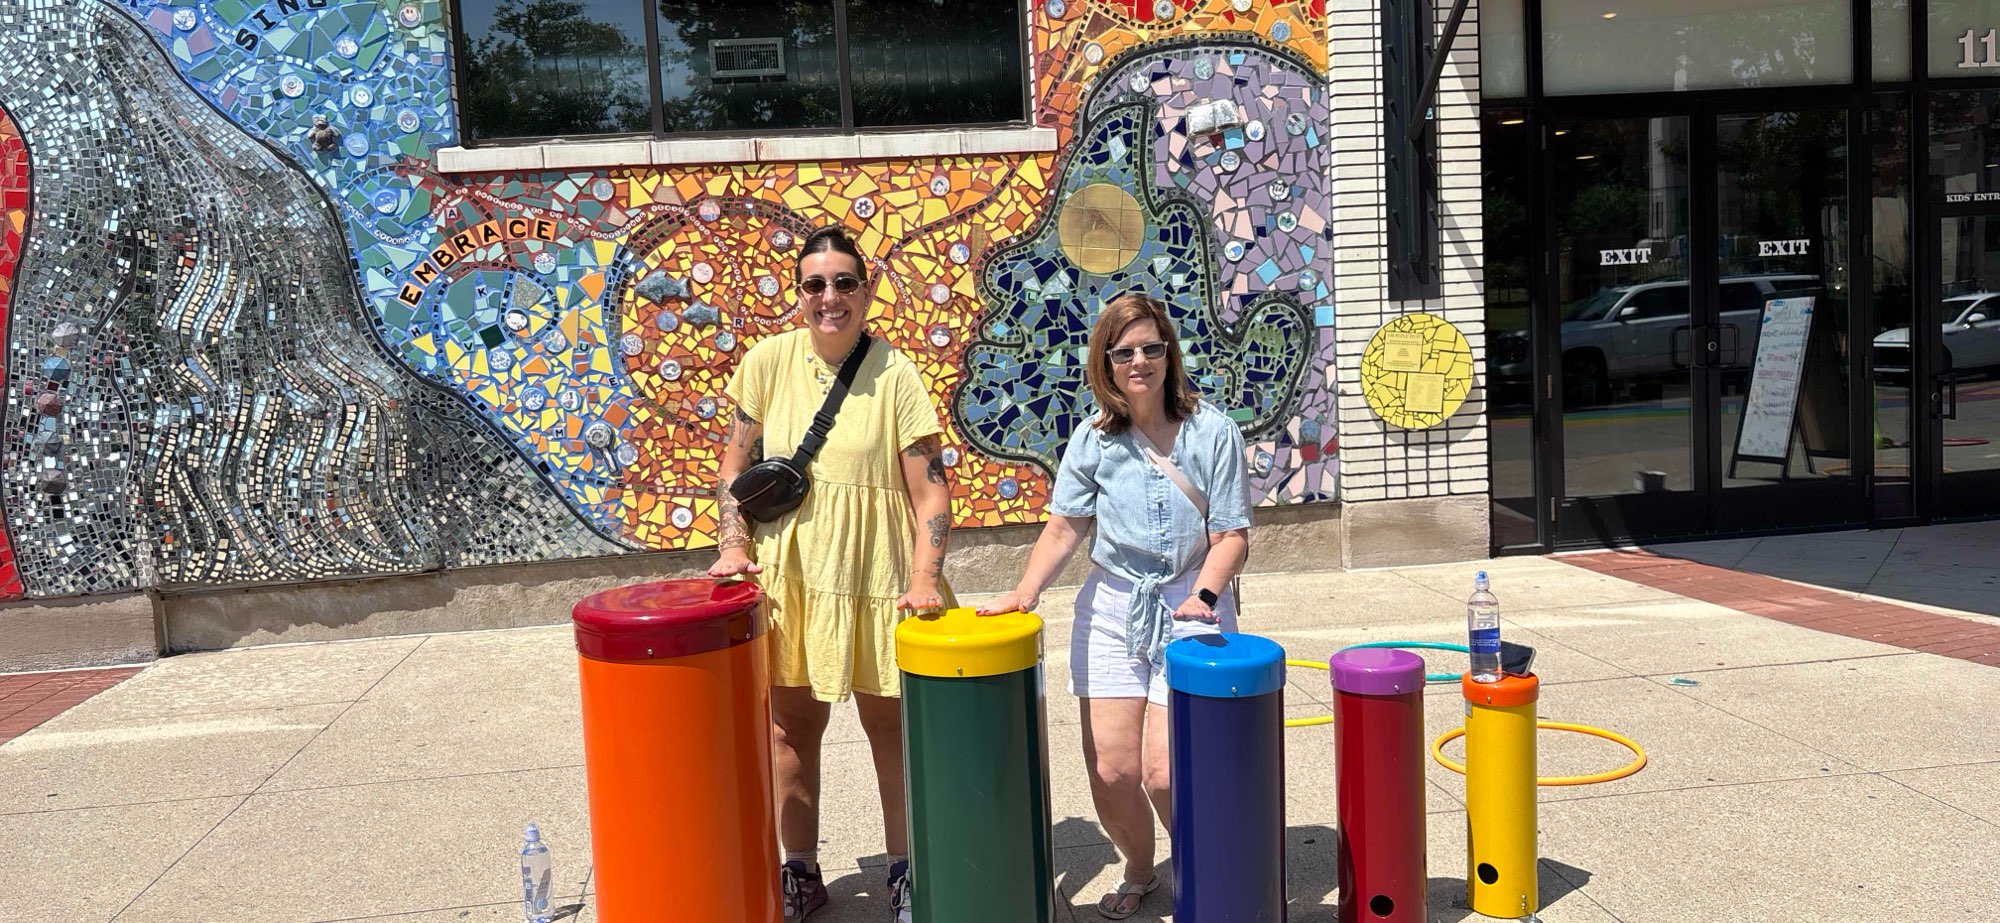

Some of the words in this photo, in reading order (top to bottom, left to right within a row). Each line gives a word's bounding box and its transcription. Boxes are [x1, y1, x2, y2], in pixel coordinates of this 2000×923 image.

[1958, 29, 2000, 68] 11
[1946, 194, 1972, 202] KIDS'
[1599, 247, 1651, 266] EXIT
[1758, 239, 1810, 257] EXIT
[400, 221, 552, 305] EMBRACE
